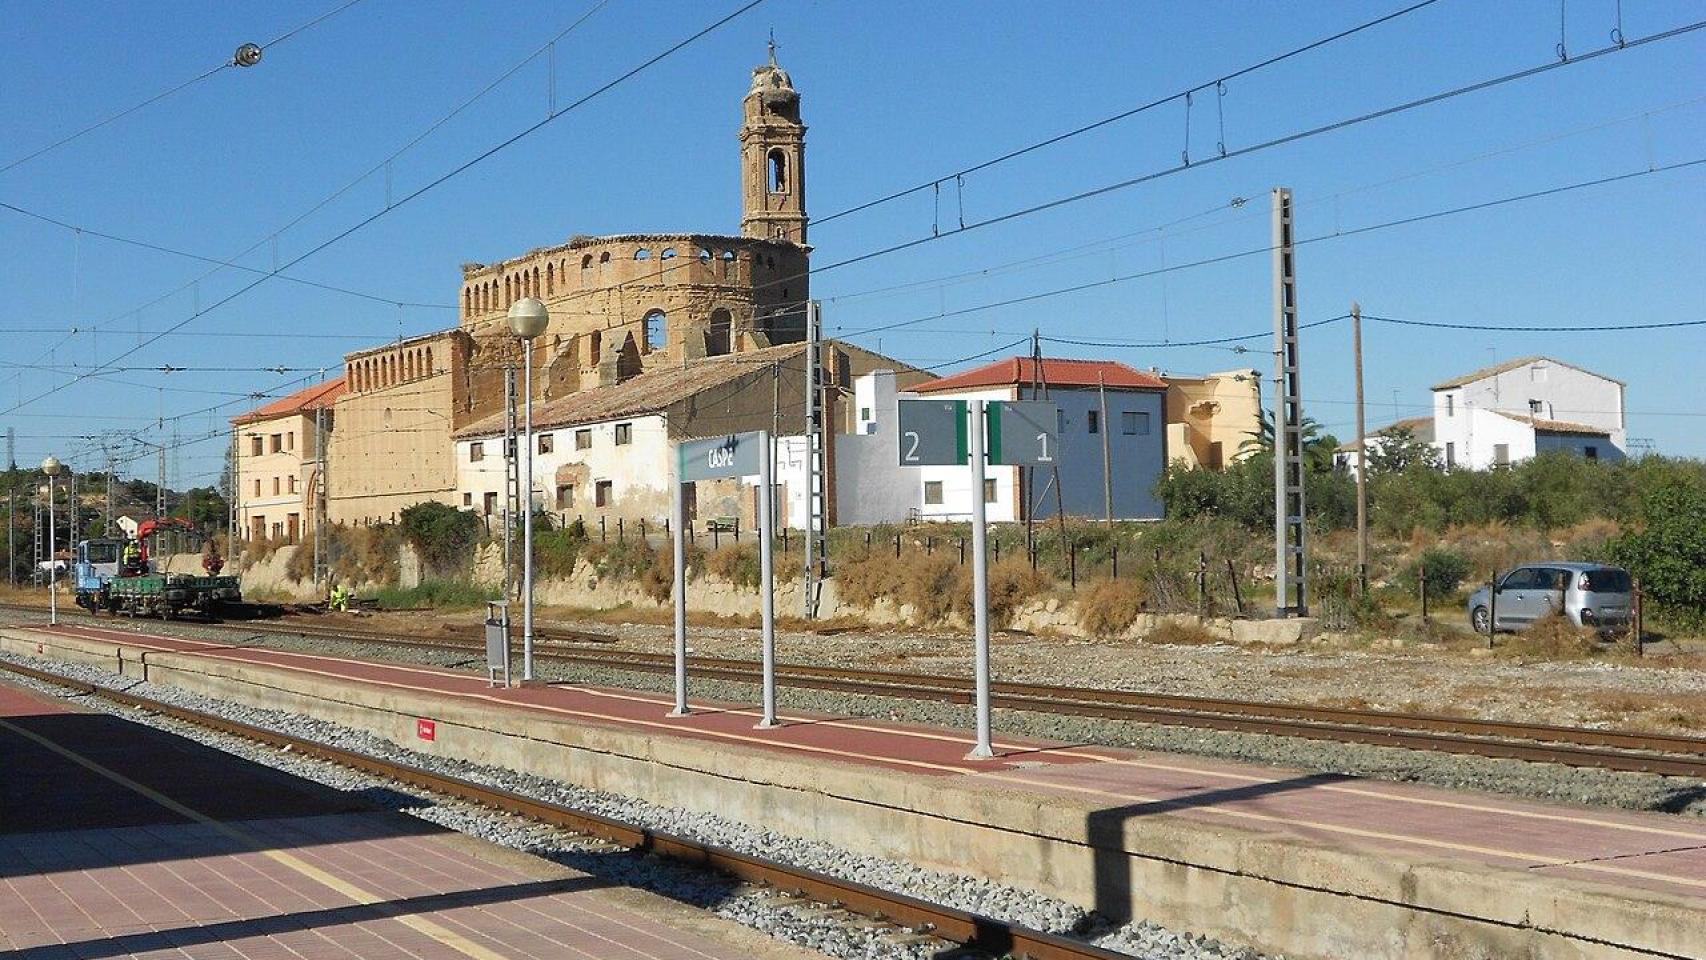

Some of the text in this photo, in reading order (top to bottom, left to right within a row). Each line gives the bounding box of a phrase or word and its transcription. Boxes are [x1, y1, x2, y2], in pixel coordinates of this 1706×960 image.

[708, 447, 734, 469] CASPE
[904, 431, 919, 461] 2
[1036, 432, 1053, 462] 1
